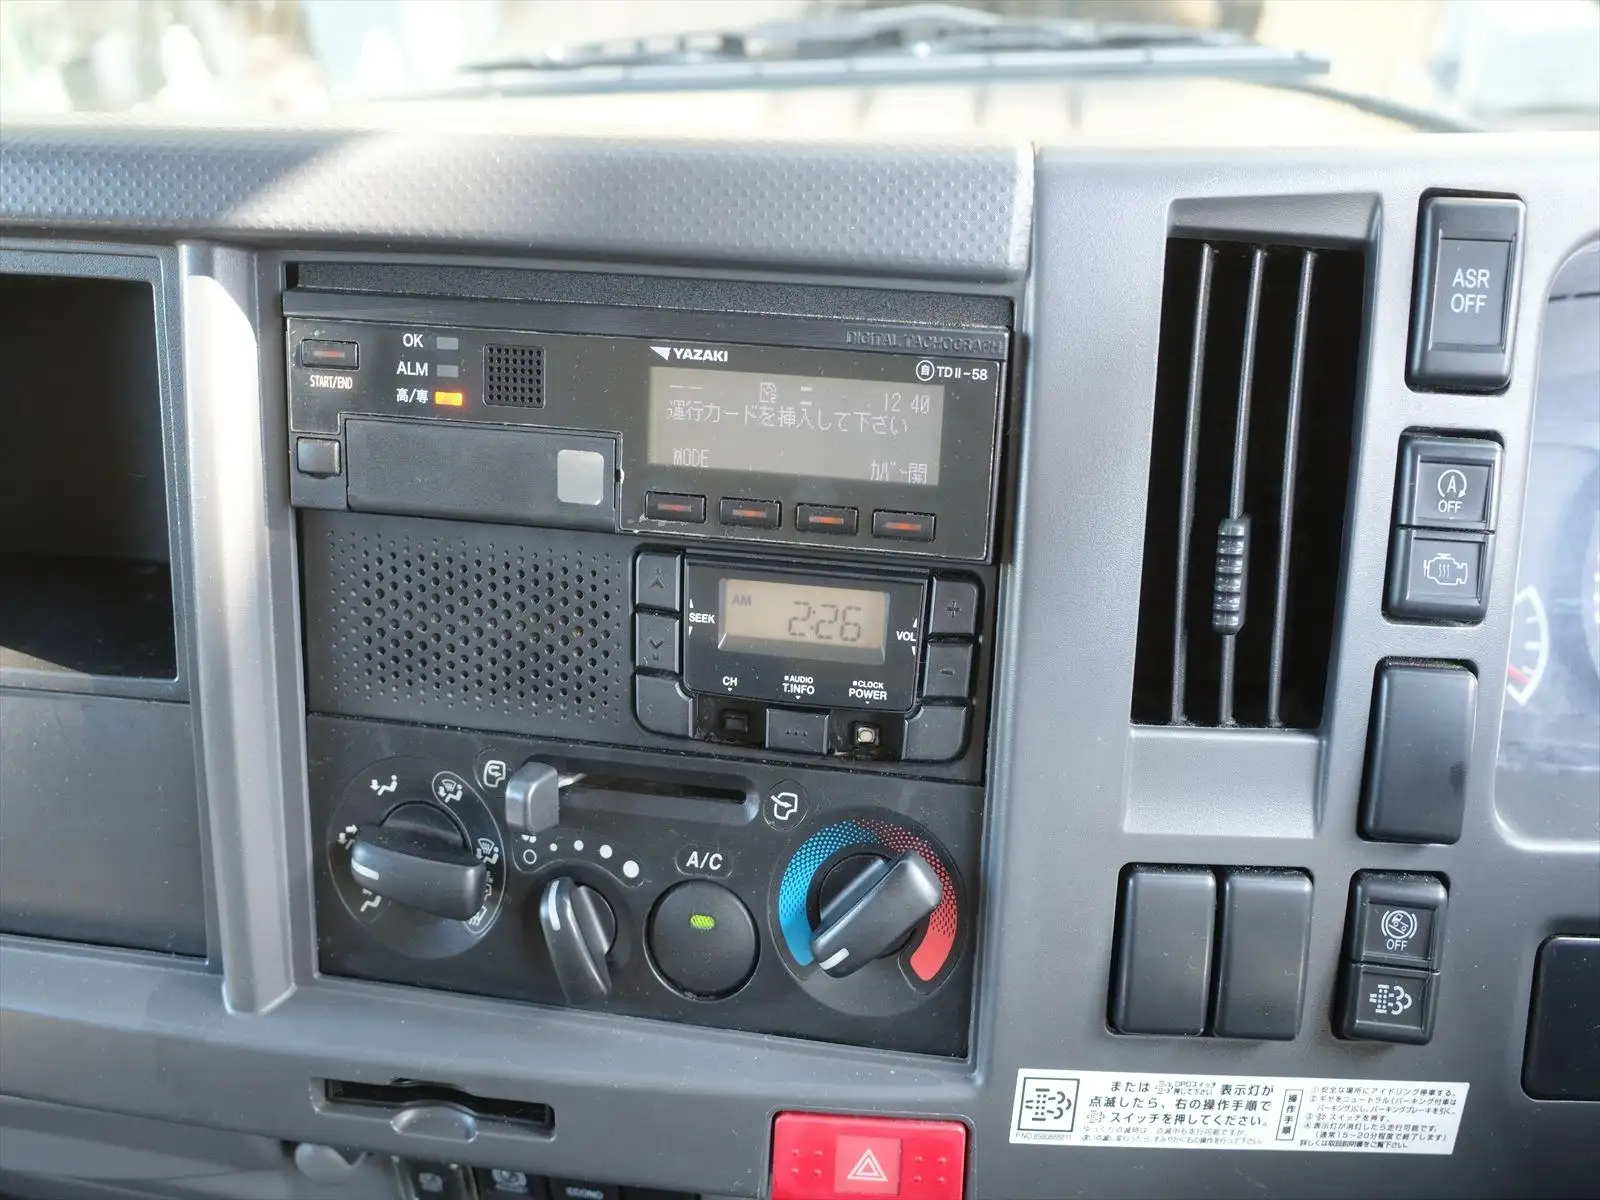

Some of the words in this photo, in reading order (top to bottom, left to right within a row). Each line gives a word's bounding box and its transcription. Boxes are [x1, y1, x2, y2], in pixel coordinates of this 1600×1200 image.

[1452, 268, 1490, 288] ASR
[1451, 293, 1488, 313] OFF
[403, 333, 424, 348] OK
[846, 331, 898, 346] DIGITAL
[673, 347, 728, 362] YAZAKI
[397, 361, 428, 377] ALM
[309, 375, 353, 390] START/END
[667, 398, 910, 436] 運行カードを挿入して下さい
[673, 448, 710, 468] MODE
[1438, 500, 1463, 513] OFF
[732, 594, 752, 606] AM
[689, 613, 715, 625] SEEK
[788, 601, 861, 642] 2:26
[896, 631, 916, 642] VOL
[722, 676, 738, 687] CH
[789, 675, 814, 684] AUDIO
[858, 680, 884, 689] CLOCK
[783, 683, 815, 695] T.INFO
[849, 688, 888, 701] POWER
[686, 852, 723, 870] A/C
[1386, 938, 1408, 950] OFF
[1110, 1081, 1150, 1093] または
[1220, 1084, 1274, 1097] 表示灯が
[1281, 1094, 1298, 1135] 操作手順
